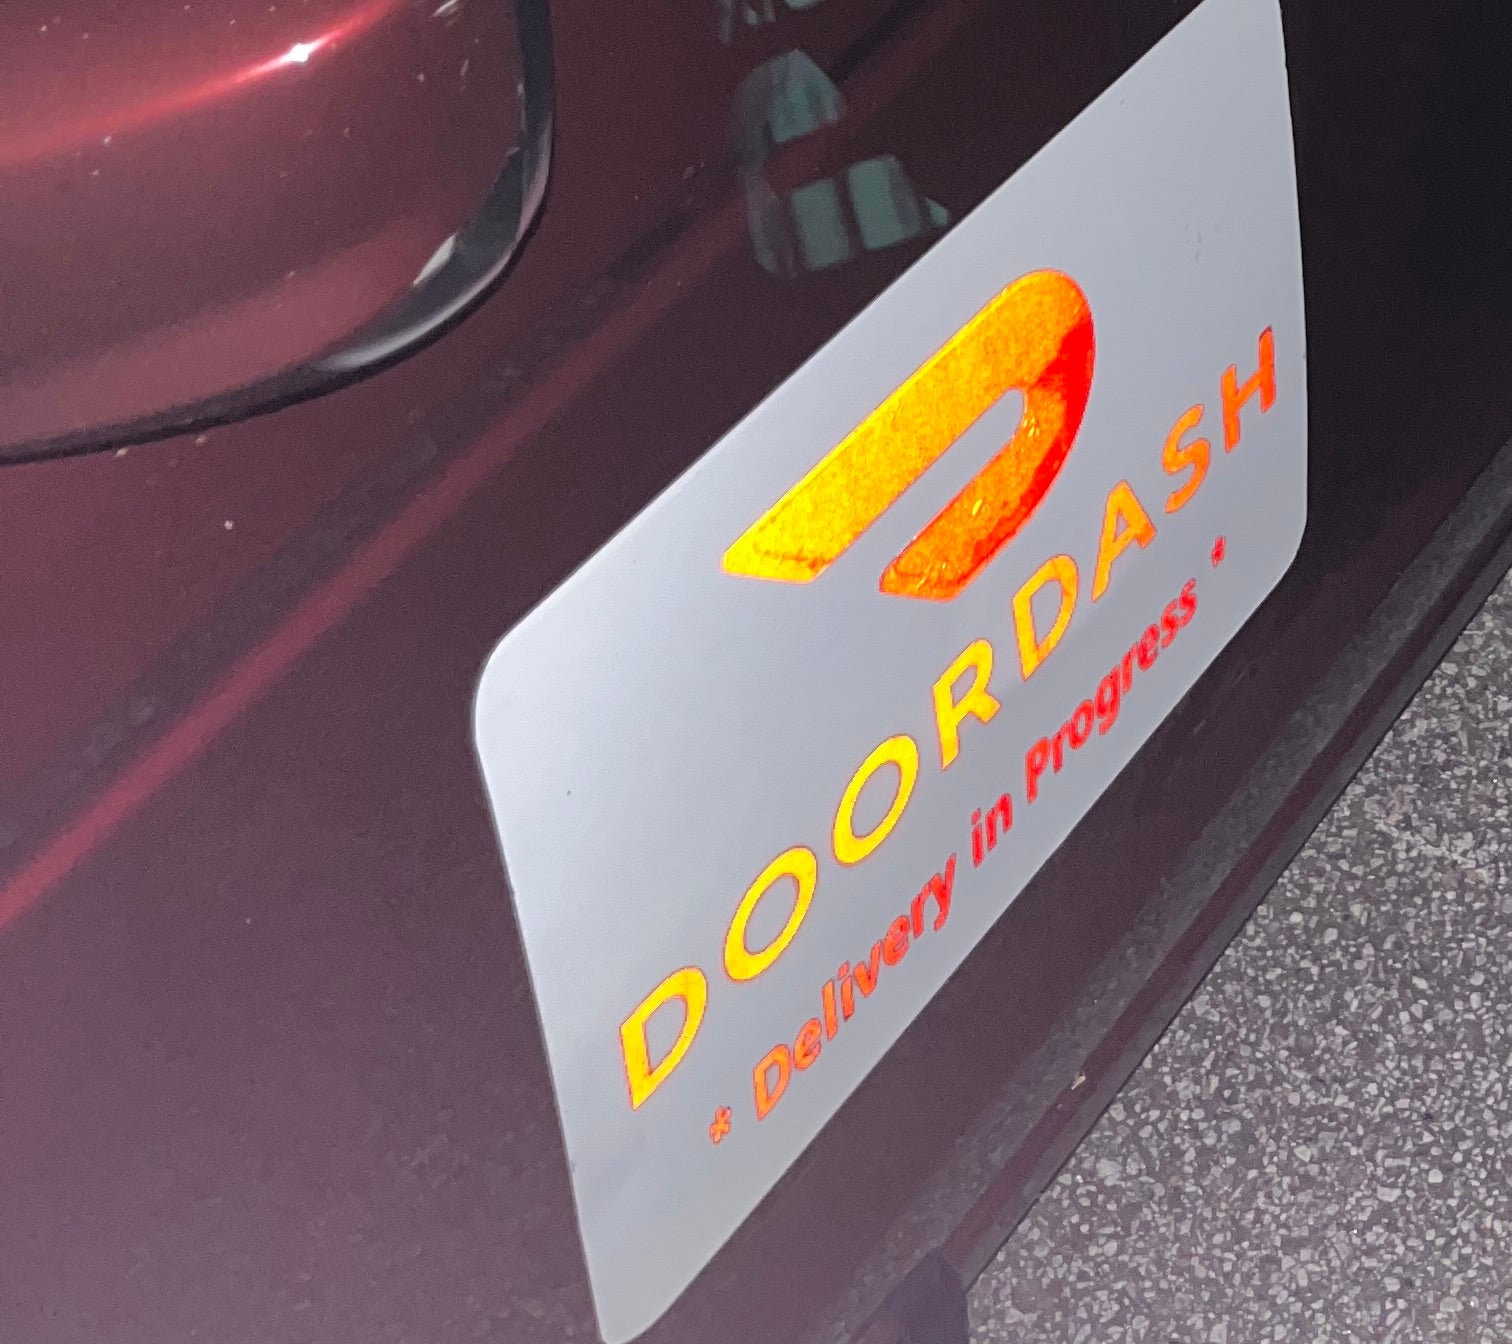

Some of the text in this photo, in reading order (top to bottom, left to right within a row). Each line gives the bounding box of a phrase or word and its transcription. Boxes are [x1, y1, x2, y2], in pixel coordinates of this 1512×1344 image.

[618, 325, 1278, 1109] DOORDASH
[753, 580, 1198, 1120] Delivery in Progress
